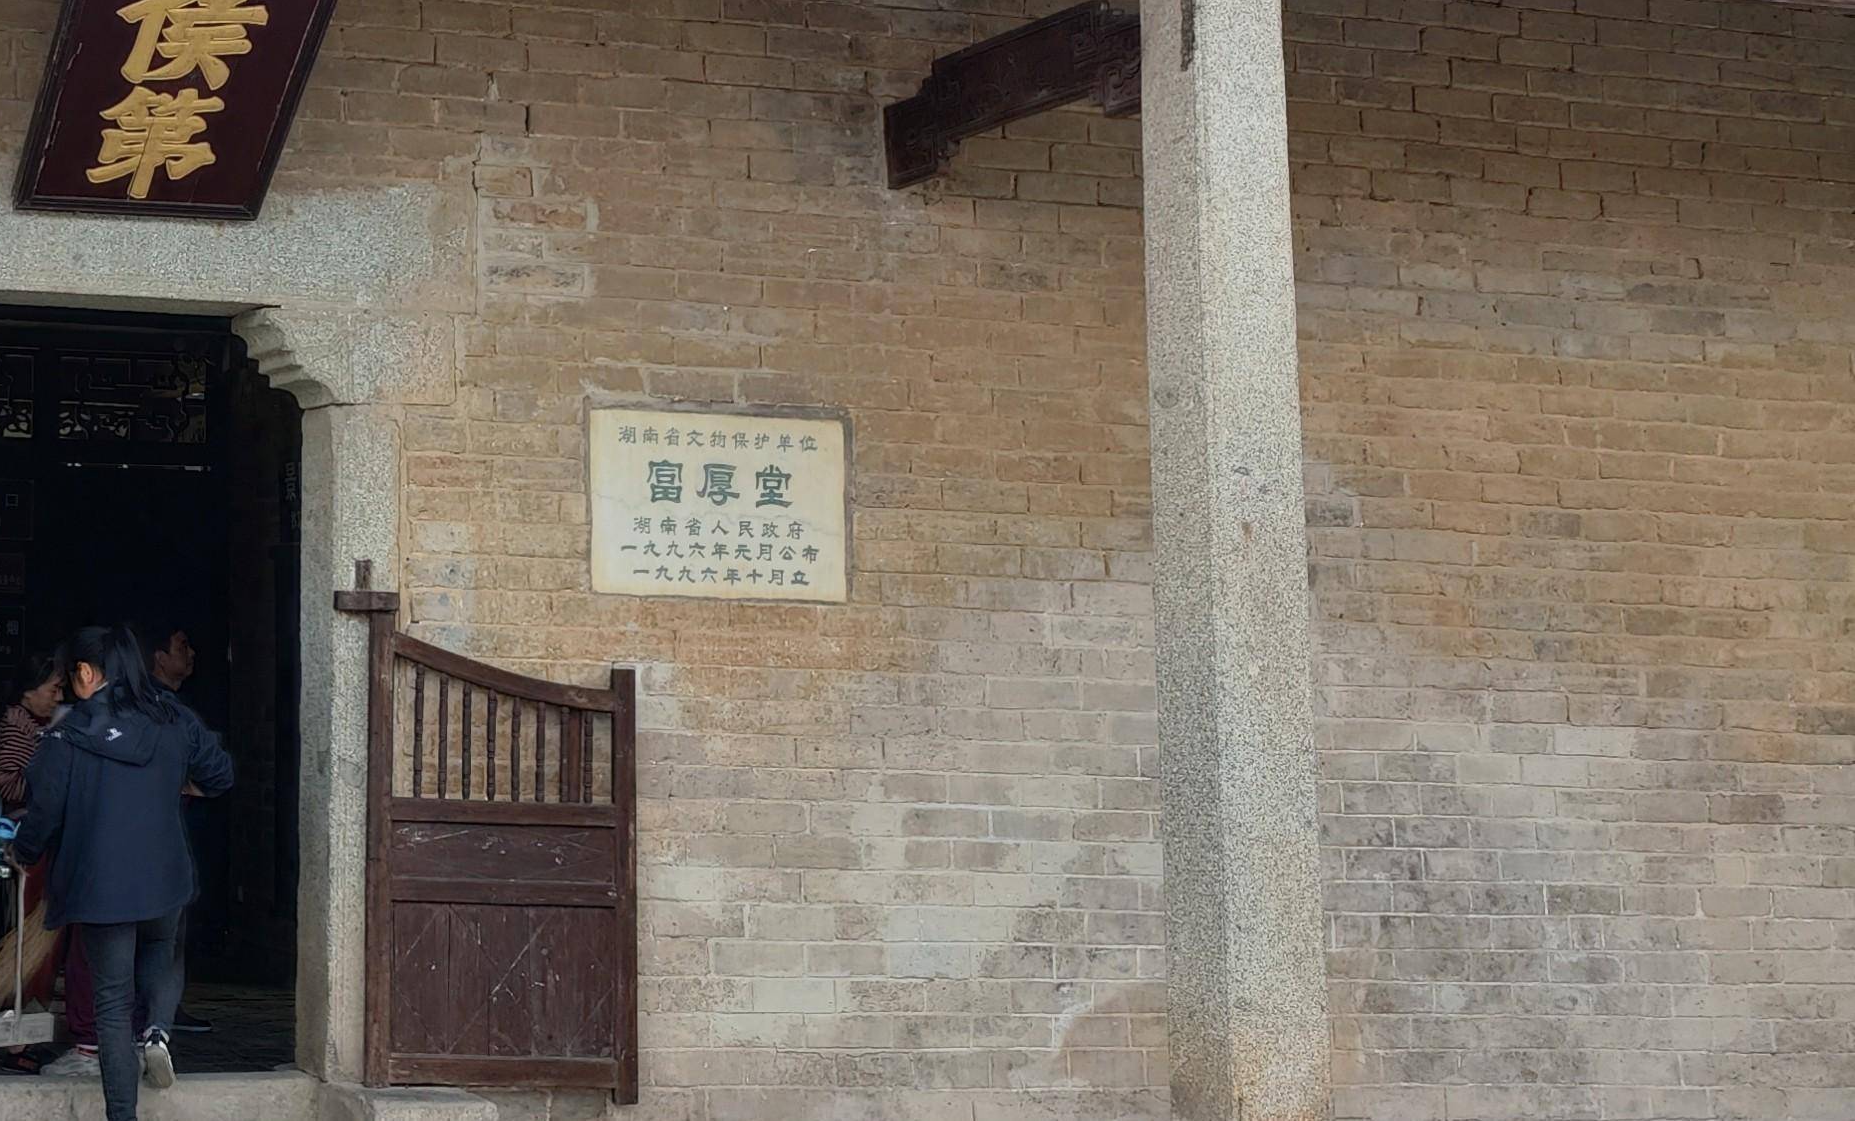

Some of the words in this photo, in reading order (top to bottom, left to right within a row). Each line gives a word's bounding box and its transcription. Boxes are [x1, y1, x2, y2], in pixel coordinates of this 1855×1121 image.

[618, 426, 818, 452] 湖南省文物保护单位
[646, 459, 793, 508] 富厚堂
[633, 516, 804, 540] 湖南省人民政府
[621, 540, 819, 564] 一九九六年元月公布
[633, 565, 810, 586] 一九九六年十月立
